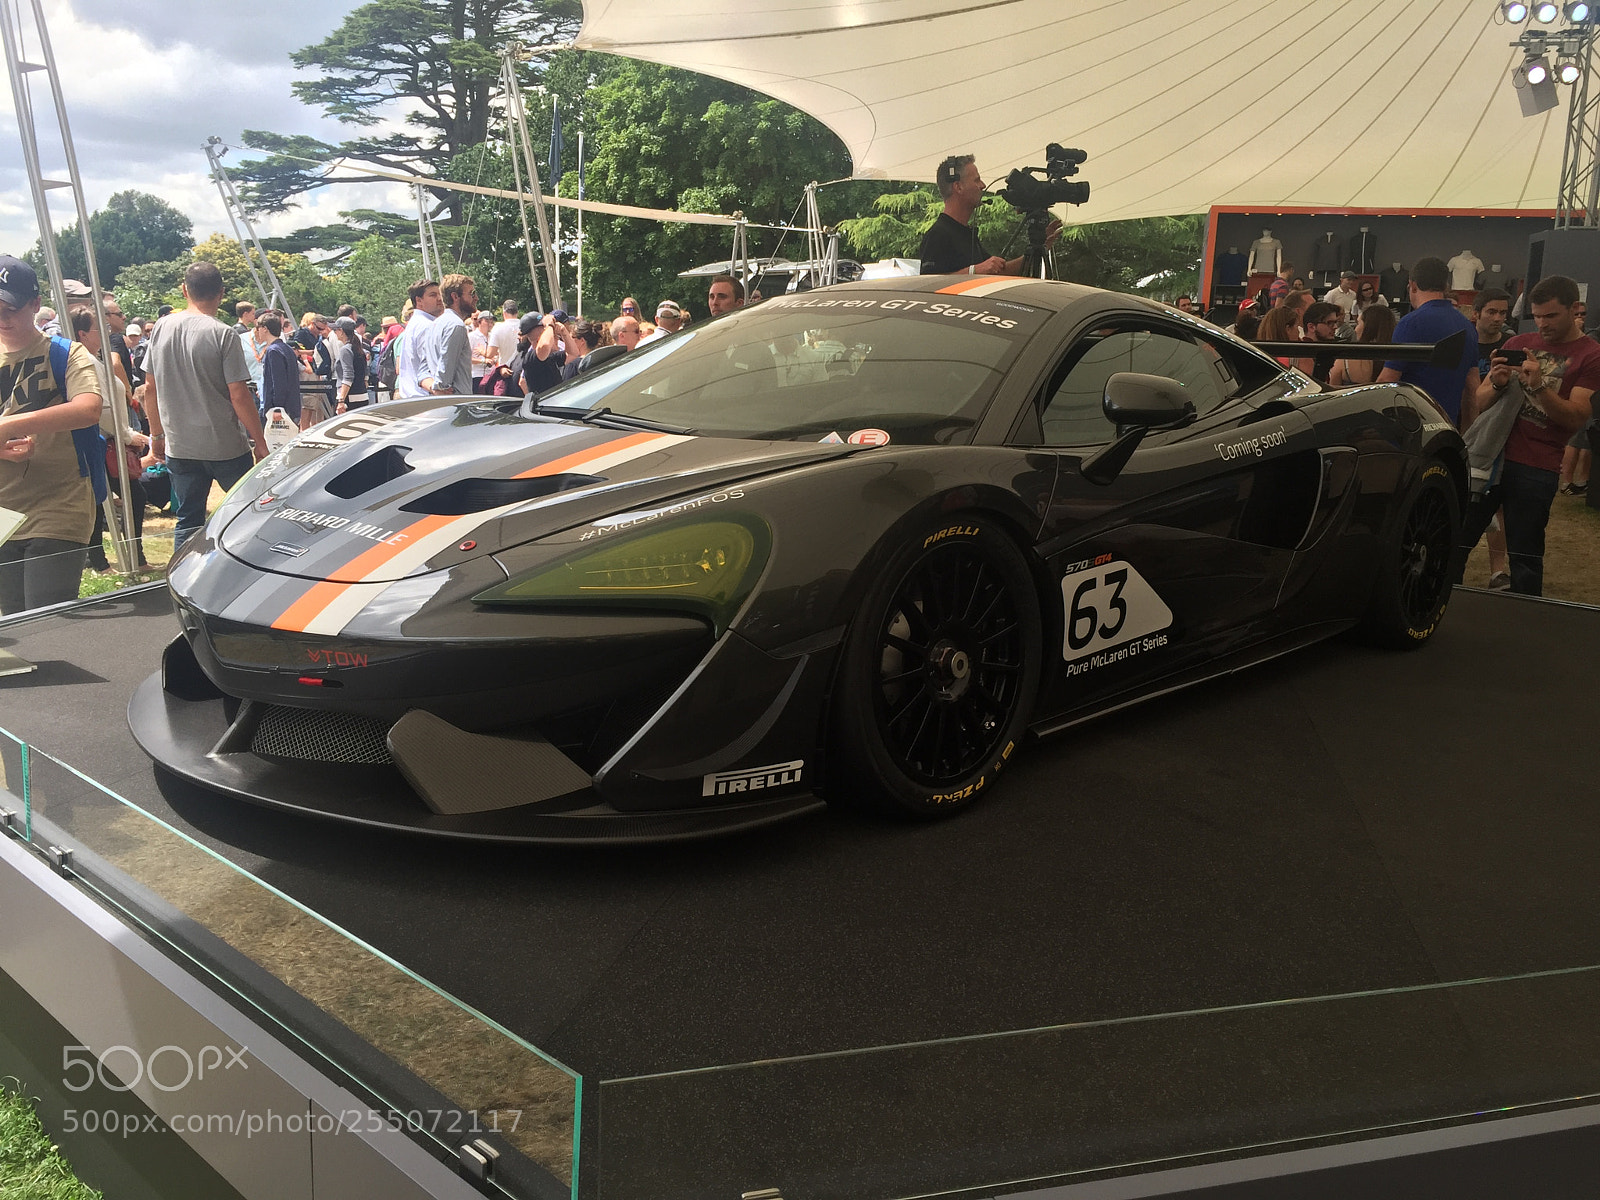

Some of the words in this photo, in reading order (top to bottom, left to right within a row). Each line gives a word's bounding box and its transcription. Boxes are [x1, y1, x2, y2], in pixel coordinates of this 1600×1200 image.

[768, 298, 877, 310] McLaren
[880, 299, 927, 311] GT
[923, 303, 1018, 329] Series
[1422, 465, 1448, 482] PIRELLI
[275, 508, 350, 529] RICHARD
[345, 522, 409, 546] MILLE
[579, 489, 745, 542] #McLarenFOS
[923, 526, 980, 549] PIRELLI
[1068, 568, 1128, 650] 63
[319, 650, 368, 668] TOW
[1066, 661, 1088, 677] Pure
[1090, 647, 1128, 670] McLaren
[1129, 640, 1142, 656] GT
[1143, 634, 1168, 651] Series
[702, 759, 804, 797] PIRELLI
